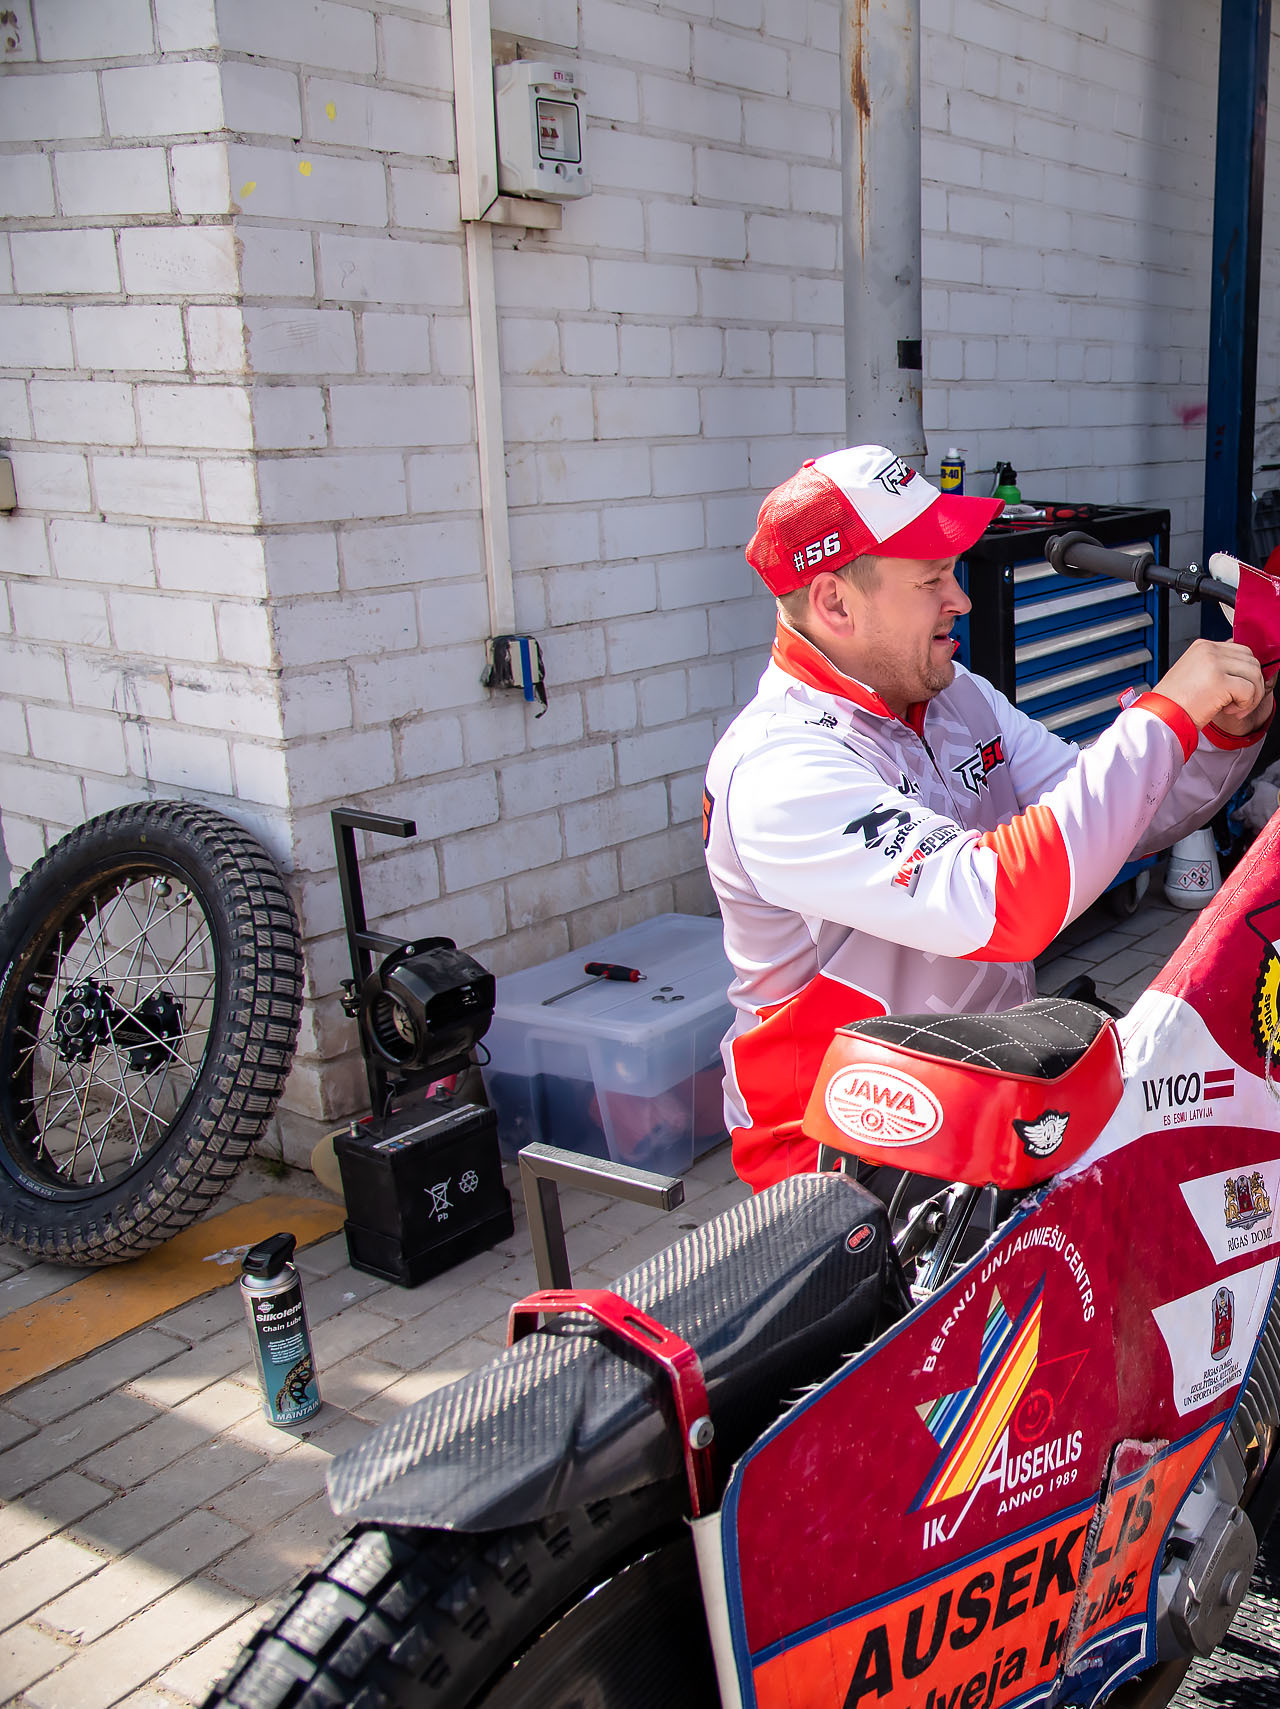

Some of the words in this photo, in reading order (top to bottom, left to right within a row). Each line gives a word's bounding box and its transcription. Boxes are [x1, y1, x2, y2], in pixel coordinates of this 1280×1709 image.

[793, 530, 842, 573] #56
[844, 1078, 917, 1116] JAWA
[1163, 1114, 1171, 1127] ES
[1173, 1111, 1188, 1124] ESMU
[1189, 1107, 1214, 1121] LATVIJA
[1250, 1226, 1273, 1245] DOME
[922, 1282, 977, 1373] BĒRNU
[981, 1251, 1004, 1284] UN
[1003, 1225, 1067, 1265] JAUNIEŠU
[1064, 1243, 1096, 1322] CENTRS
[262, 1323, 286, 1333] Chain
[286, 1315, 302, 1328] Lube
[276, 1400, 319, 1421] MAINTAIN
[996, 1484, 1044, 1517] ANNO
[1049, 1468, 1078, 1493] 1989
[922, 1514, 948, 1551] IK
